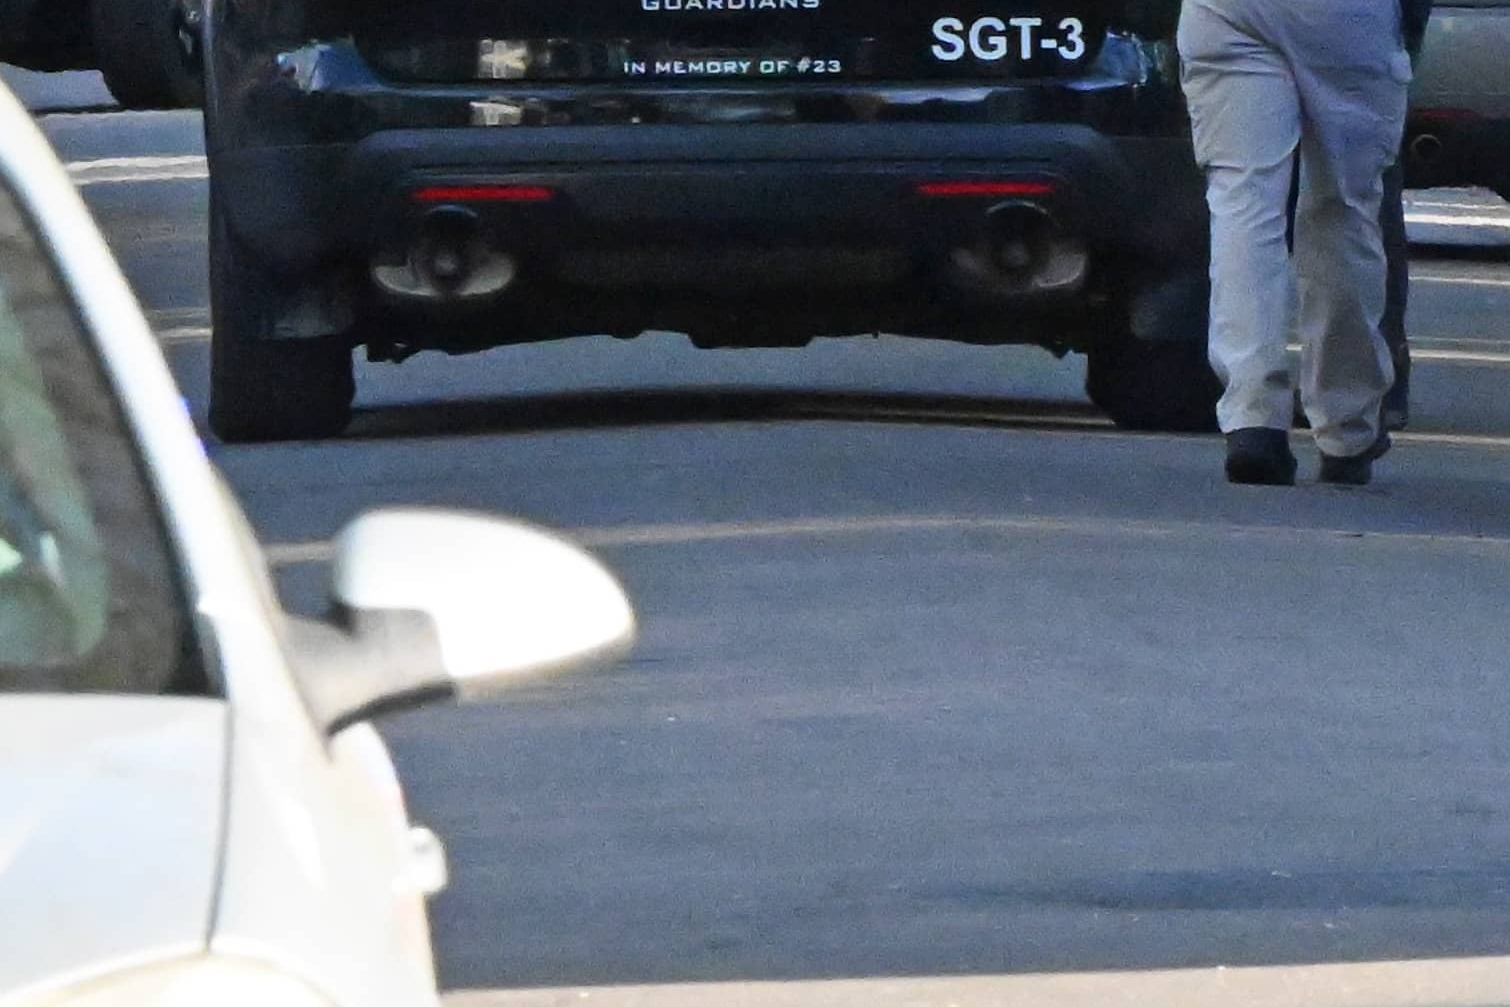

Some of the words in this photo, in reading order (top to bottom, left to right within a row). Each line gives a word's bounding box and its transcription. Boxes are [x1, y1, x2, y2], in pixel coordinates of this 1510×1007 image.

[930, 17, 1086, 61] SGT-3
[623, 60, 646, 74] IN
[655, 60, 752, 74] MEMORY
[759, 59, 791, 73] OF
[796, 56, 842, 74] #23
